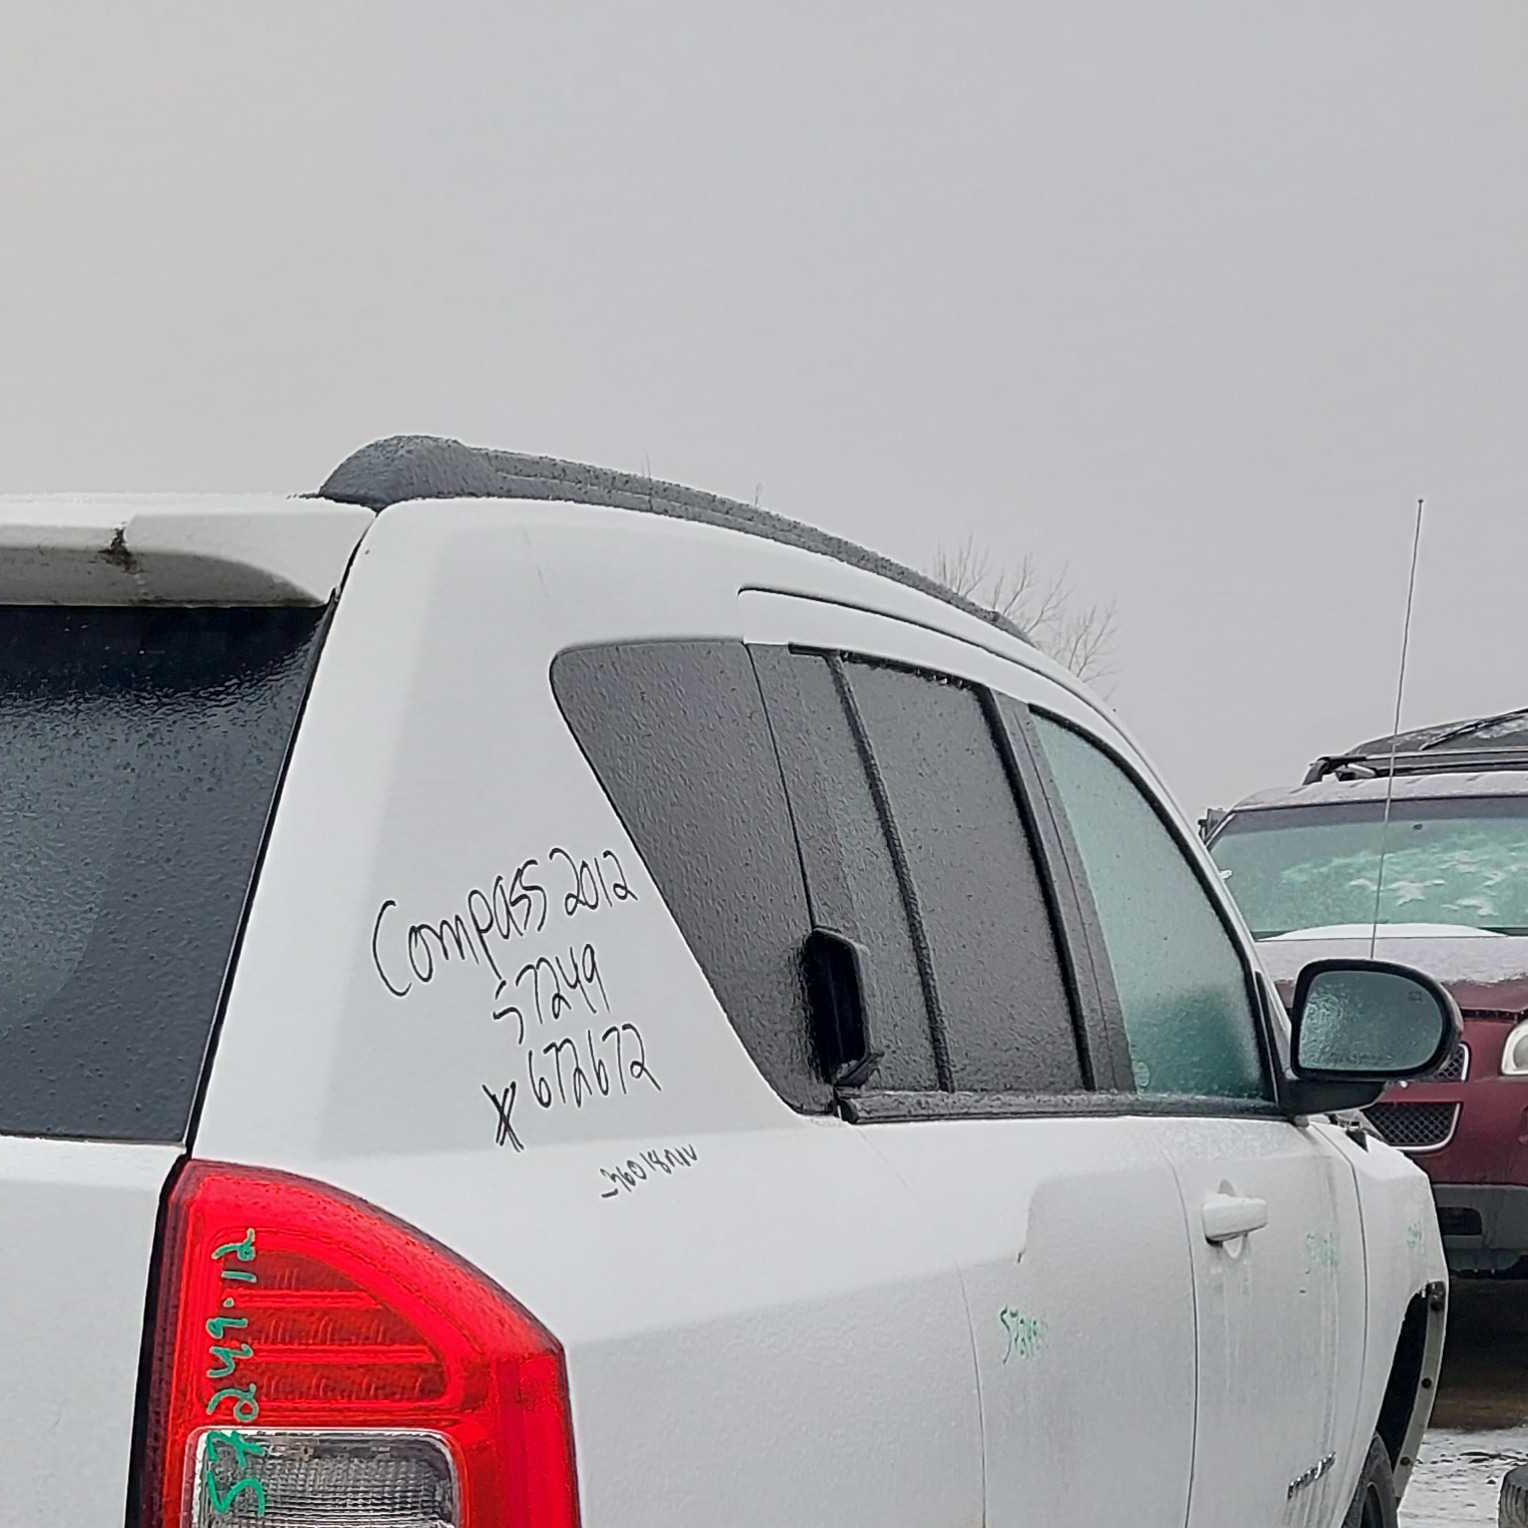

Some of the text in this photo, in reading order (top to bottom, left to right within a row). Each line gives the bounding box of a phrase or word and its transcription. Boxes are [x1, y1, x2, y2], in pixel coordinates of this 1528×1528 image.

[549, 848, 638, 917] 2012
[492, 944, 611, 1045] 57249
[528, 1023, 661, 1109] 672672
